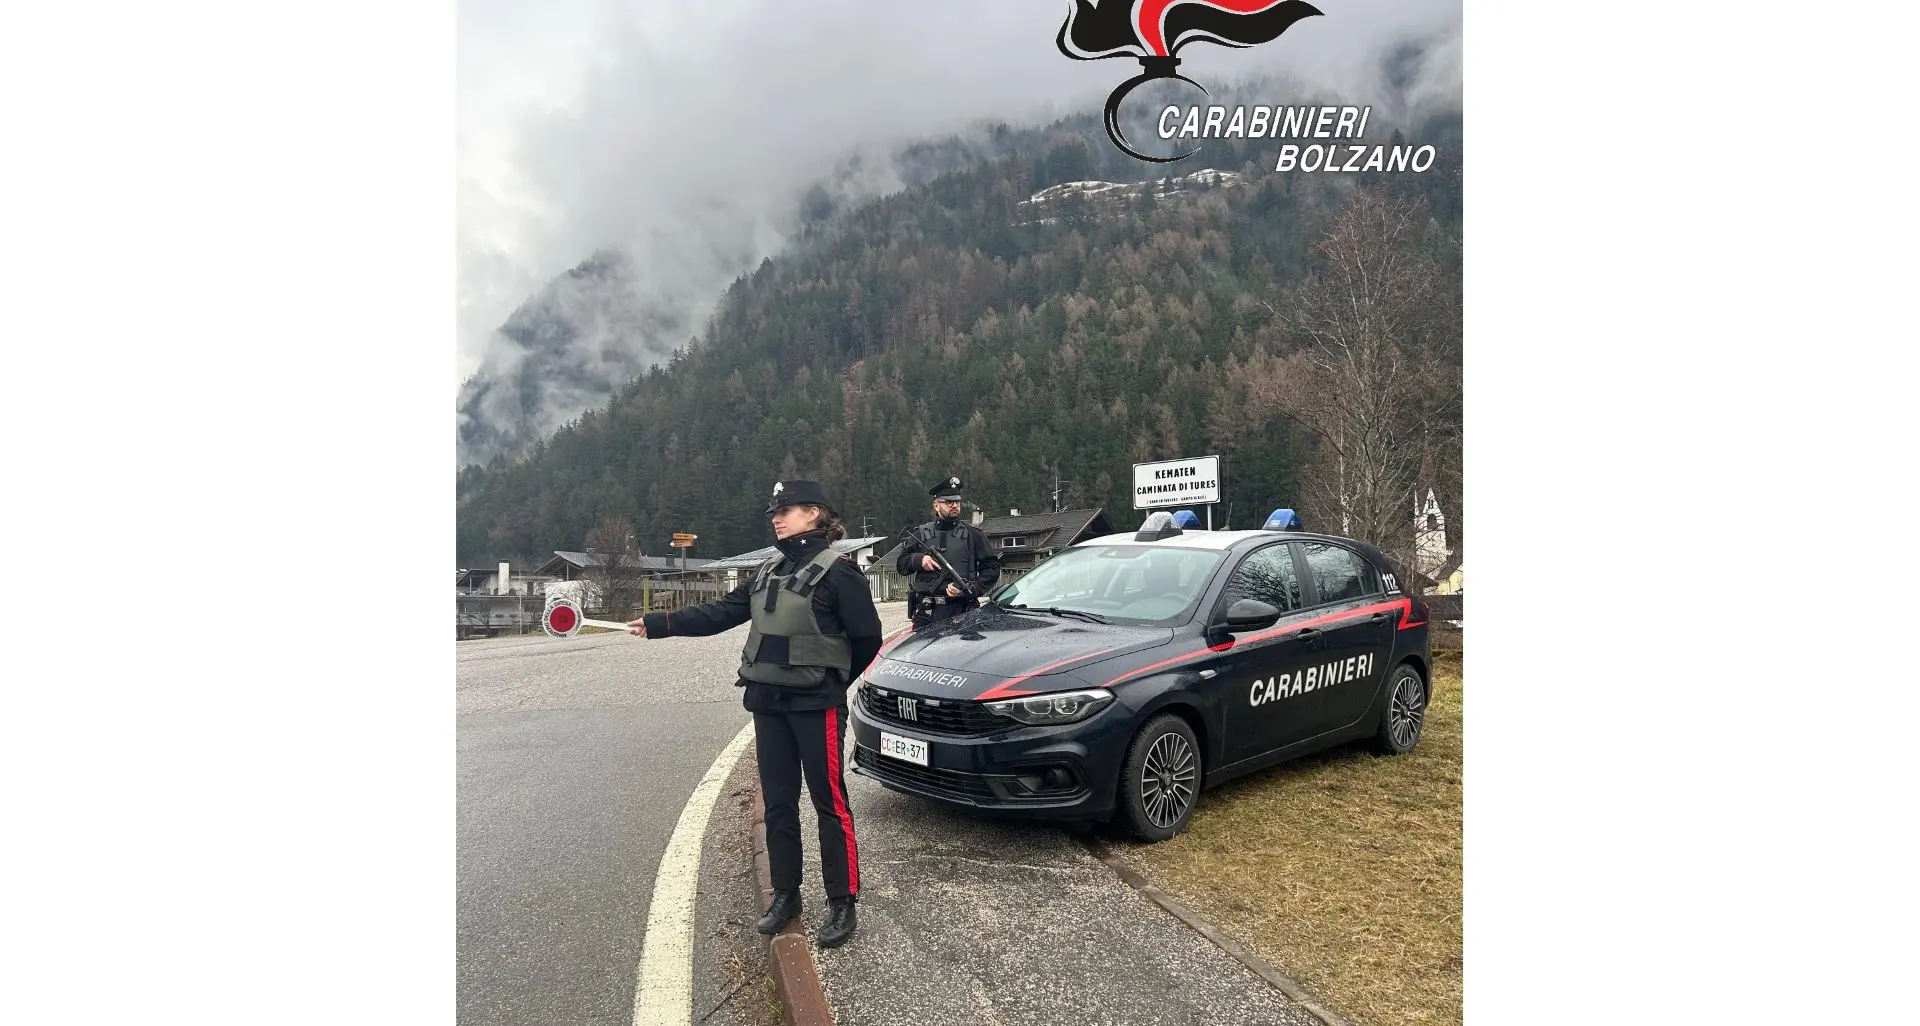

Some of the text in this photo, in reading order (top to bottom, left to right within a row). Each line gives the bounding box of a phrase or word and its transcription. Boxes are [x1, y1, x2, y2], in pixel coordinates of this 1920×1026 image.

[1155, 467, 1196, 479] KEMATEN
[1137, 480, 1216, 495] CAMINATA DI TURES
[1382, 573, 1399, 590] 112
[880, 664, 968, 688] CARABINIERI
[1250, 652, 1374, 707] CARABINIERI
[897, 696, 918, 722] FIAT
